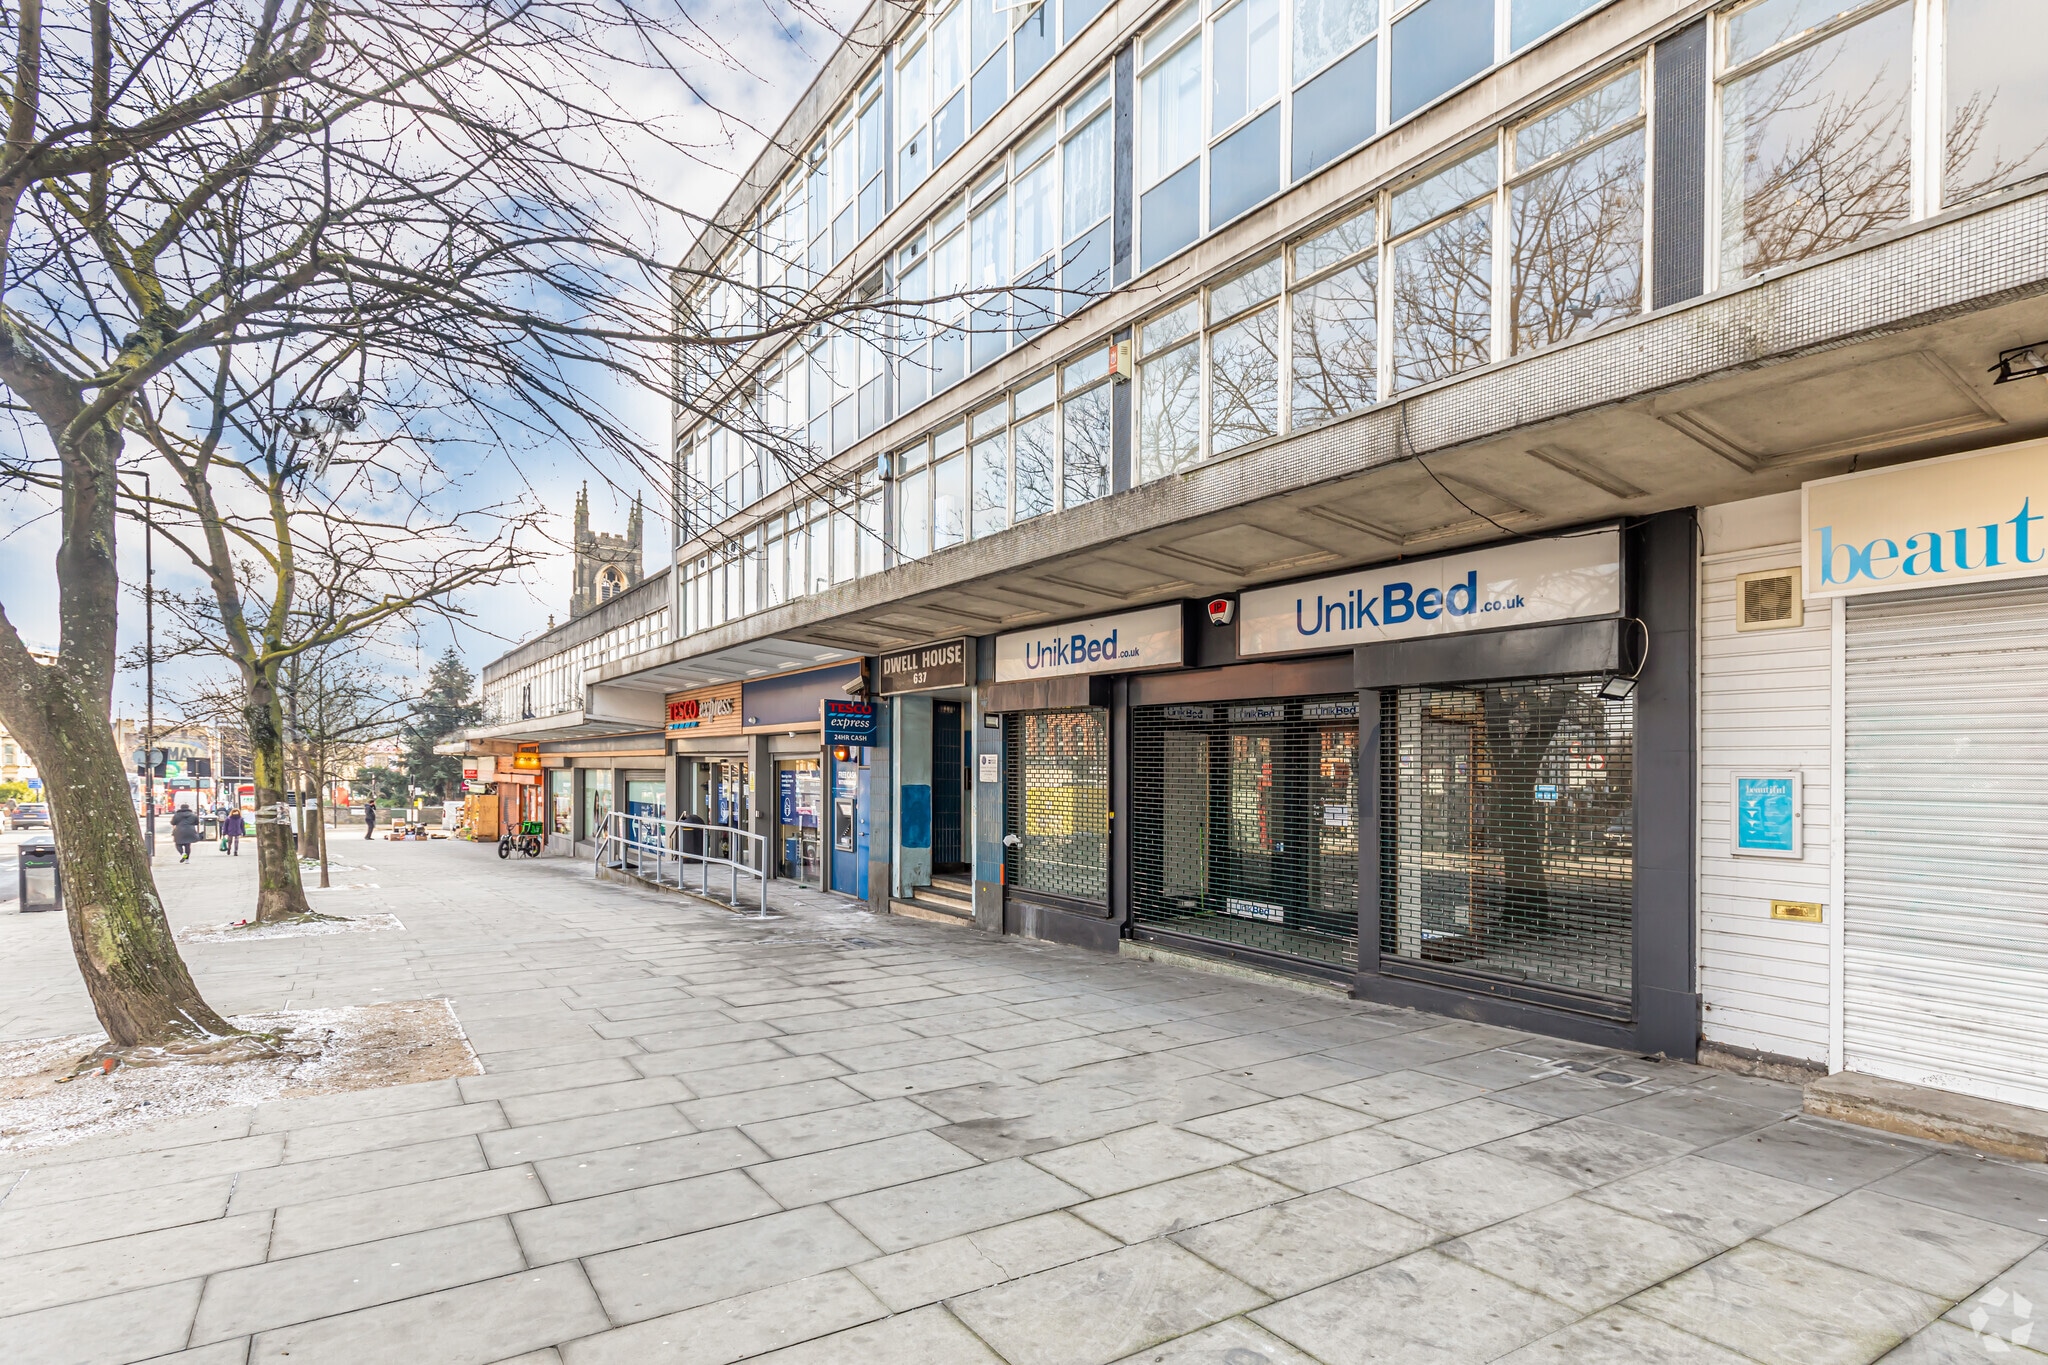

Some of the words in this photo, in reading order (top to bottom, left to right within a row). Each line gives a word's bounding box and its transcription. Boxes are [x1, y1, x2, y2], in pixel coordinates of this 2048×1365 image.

[1812, 496, 2046, 588] beaut
[1296, 571, 1525, 636] UnikBed.co.uk
[884, 654, 918, 675] DWELL
[922, 645, 962, 668] HOUSE
[1026, 628, 1140, 670] UnikBed.co.uk
[913, 672, 927, 684] 637
[668, 699, 700, 721] TESCO
[699, 697, 733, 723] express
[828, 702, 873, 714] TESCO
[831, 718, 870, 729] express
